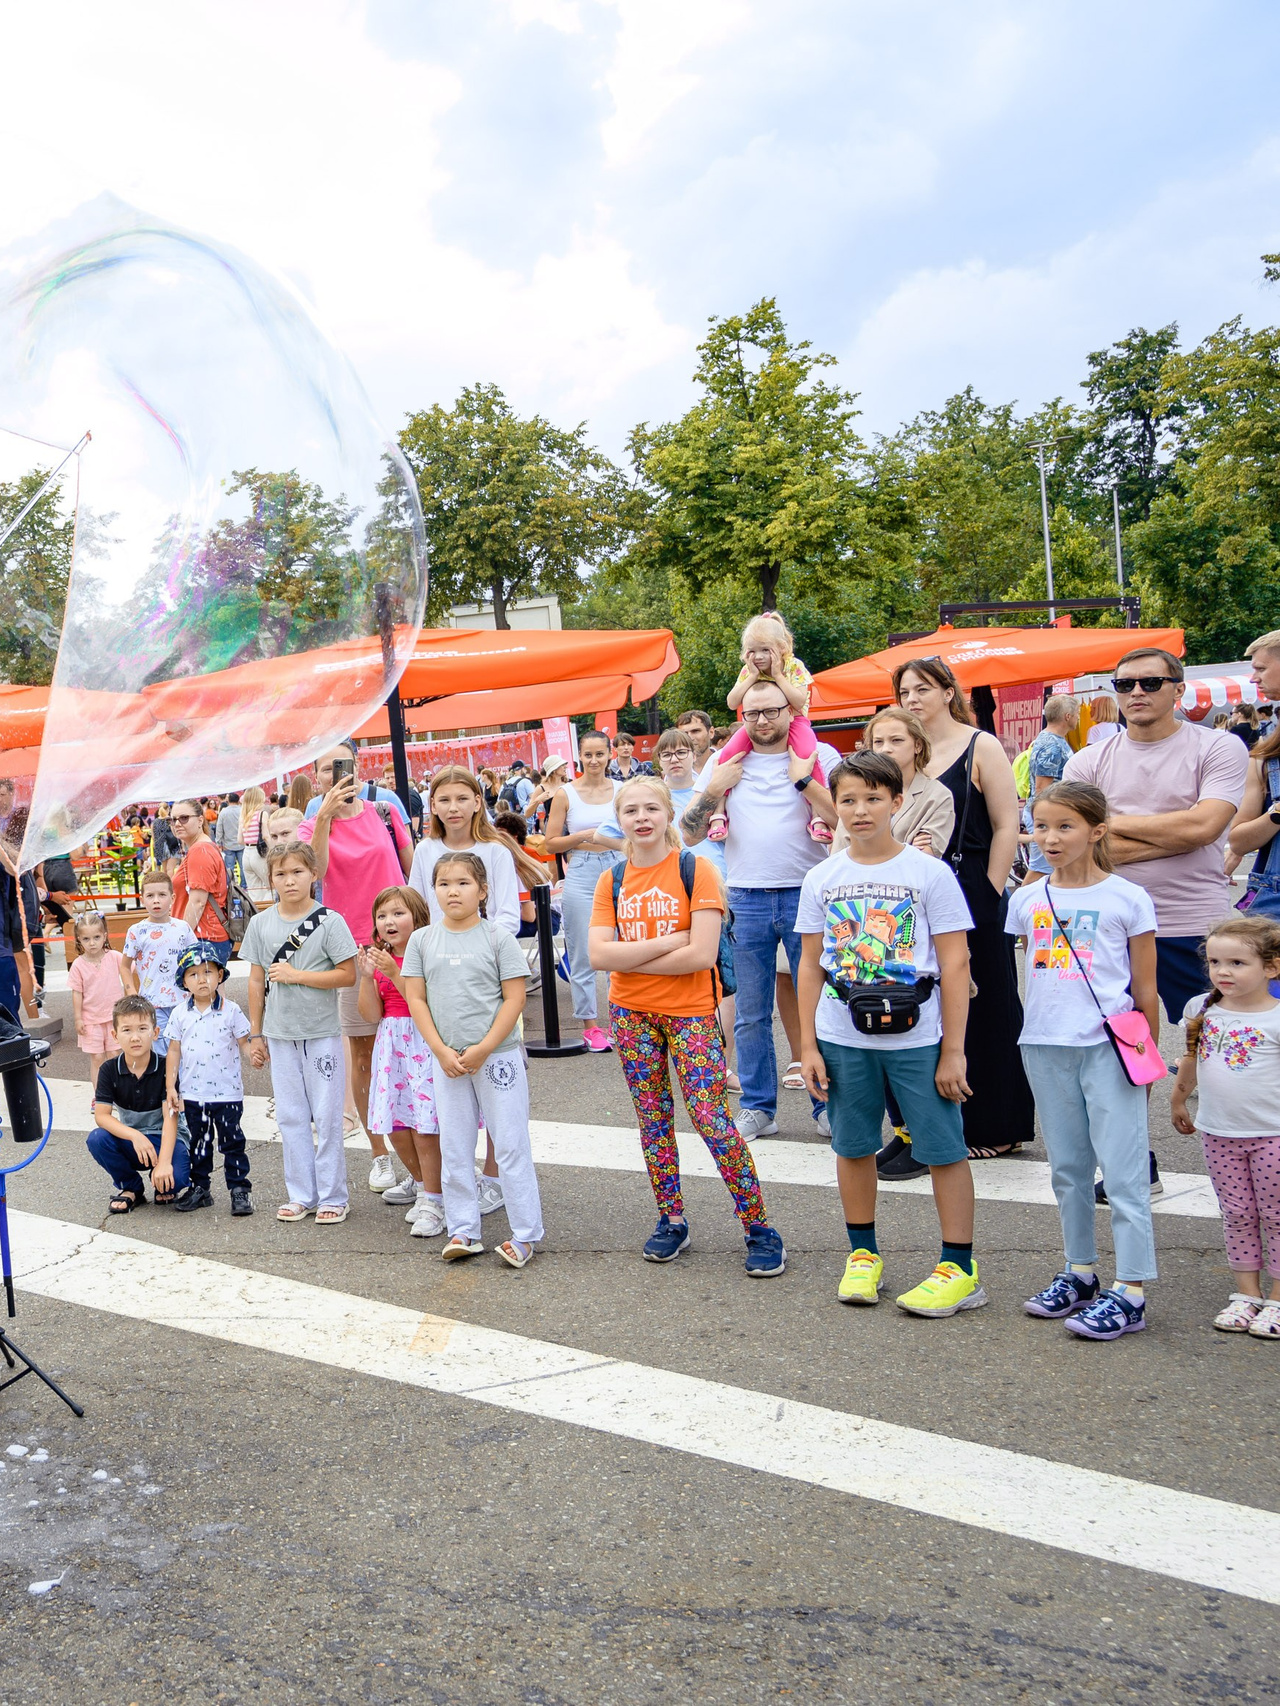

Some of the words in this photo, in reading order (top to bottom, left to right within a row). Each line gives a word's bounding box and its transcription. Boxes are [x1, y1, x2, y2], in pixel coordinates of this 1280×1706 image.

[1002, 696, 1042, 721] ЭПИЧЕСКИЙ
[822, 882, 920, 904] MINECRAFT
[647, 899, 679, 917] HIKE
[618, 921, 647, 941] AND
